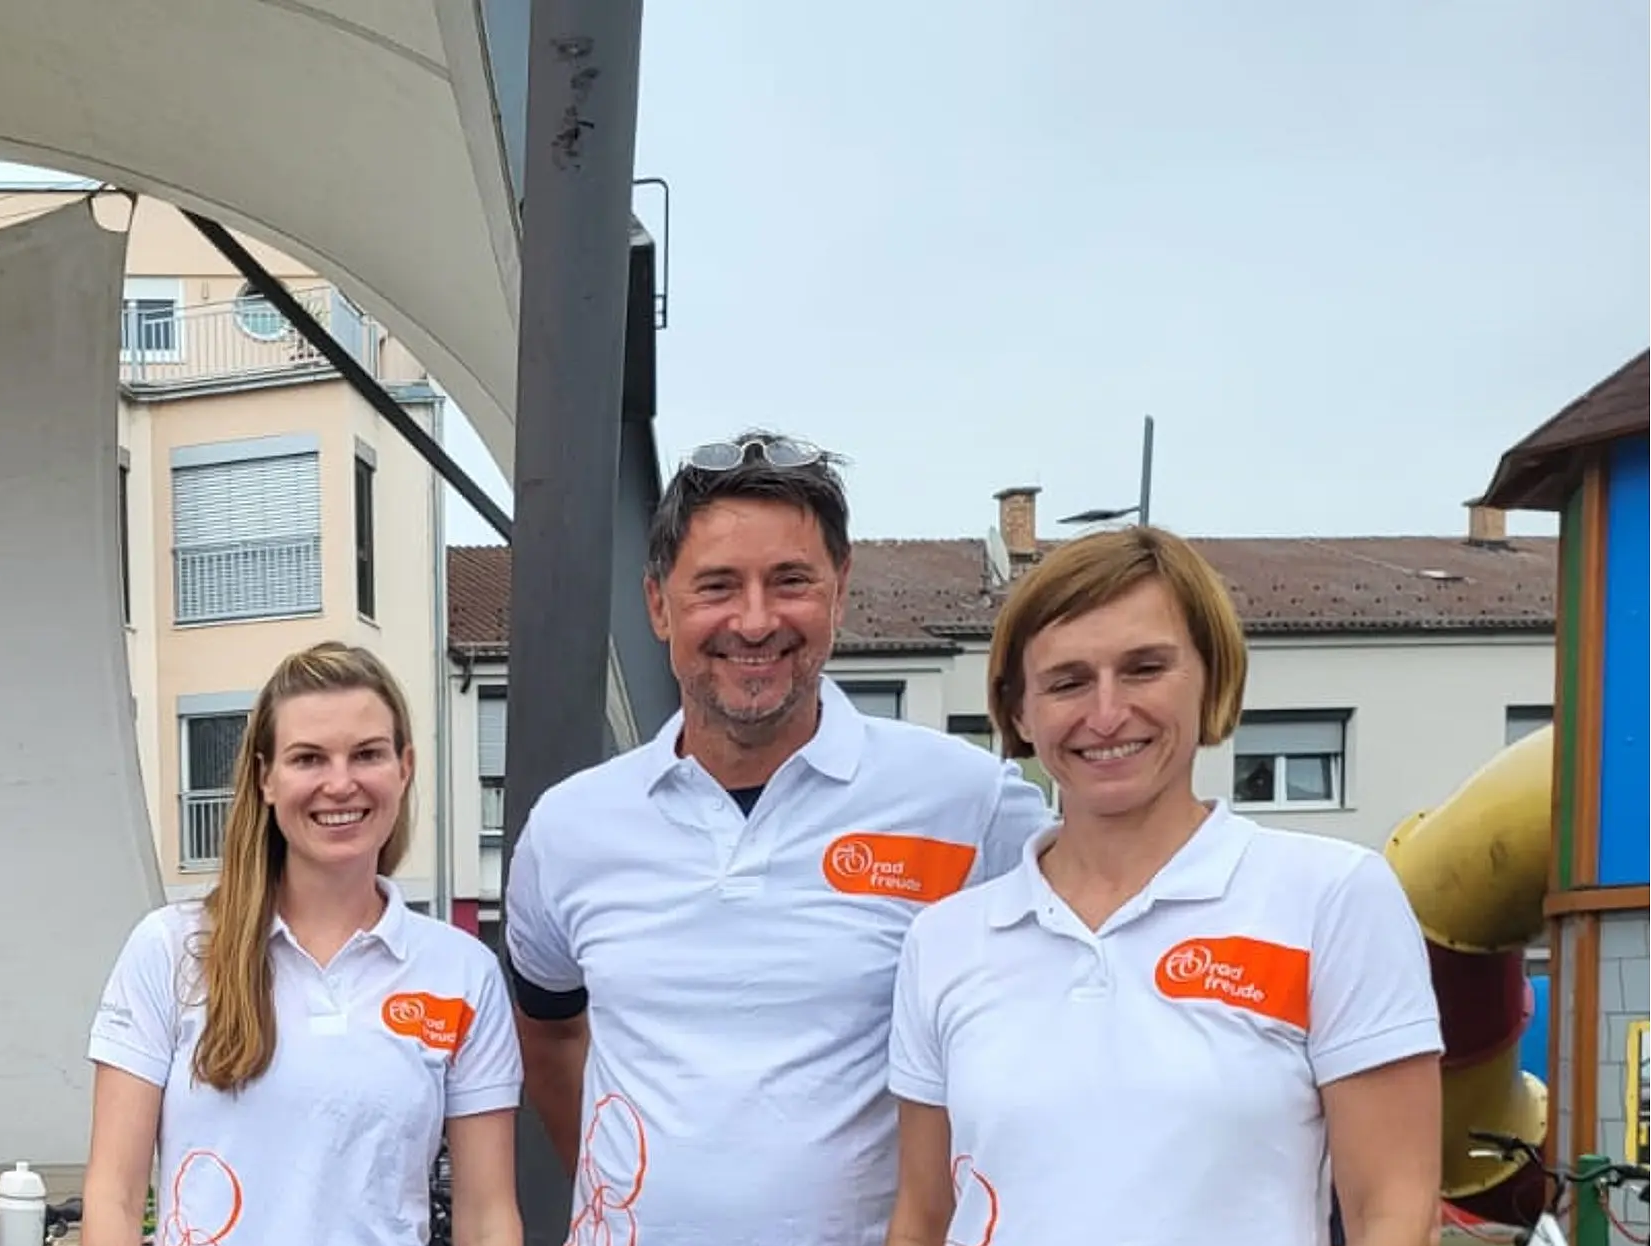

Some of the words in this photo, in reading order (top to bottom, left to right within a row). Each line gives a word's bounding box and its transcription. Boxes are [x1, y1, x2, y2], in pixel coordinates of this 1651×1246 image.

[872, 861, 905, 874] rad
[1208, 961, 1245, 981] rad
[1204, 975, 1266, 1003] freude
